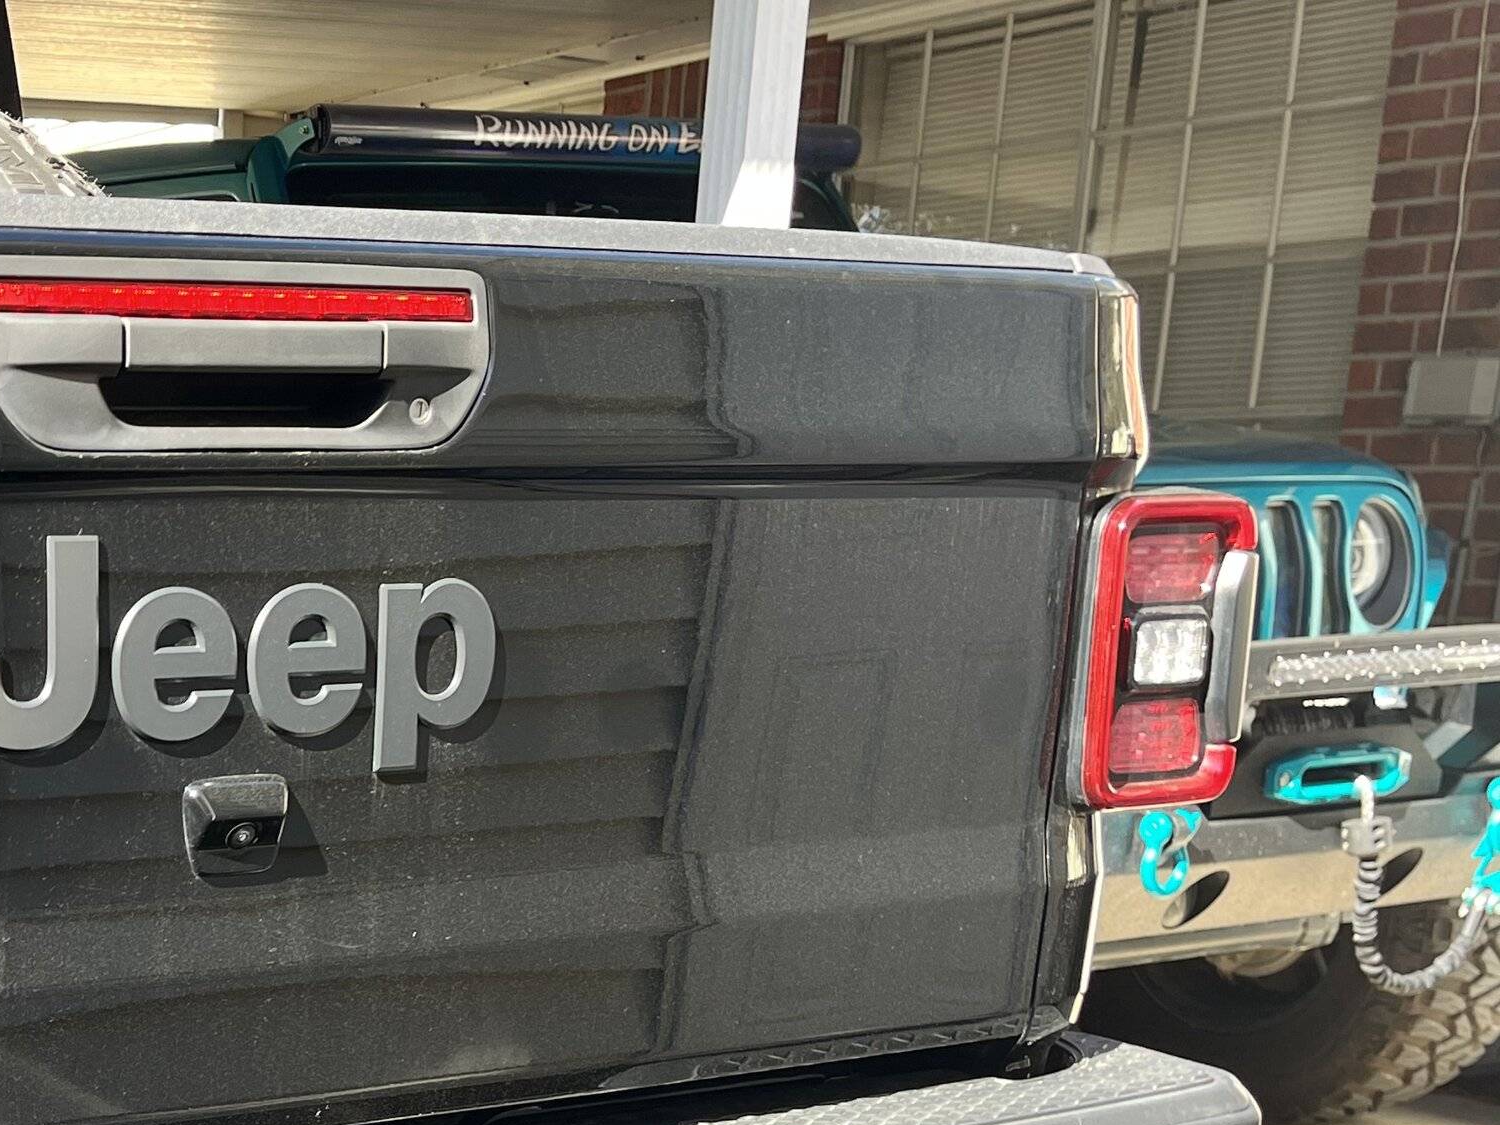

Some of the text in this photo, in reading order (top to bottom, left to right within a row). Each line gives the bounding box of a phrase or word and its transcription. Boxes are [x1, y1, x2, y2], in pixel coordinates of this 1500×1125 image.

[473, 114, 703, 154] RUNNING ON E
